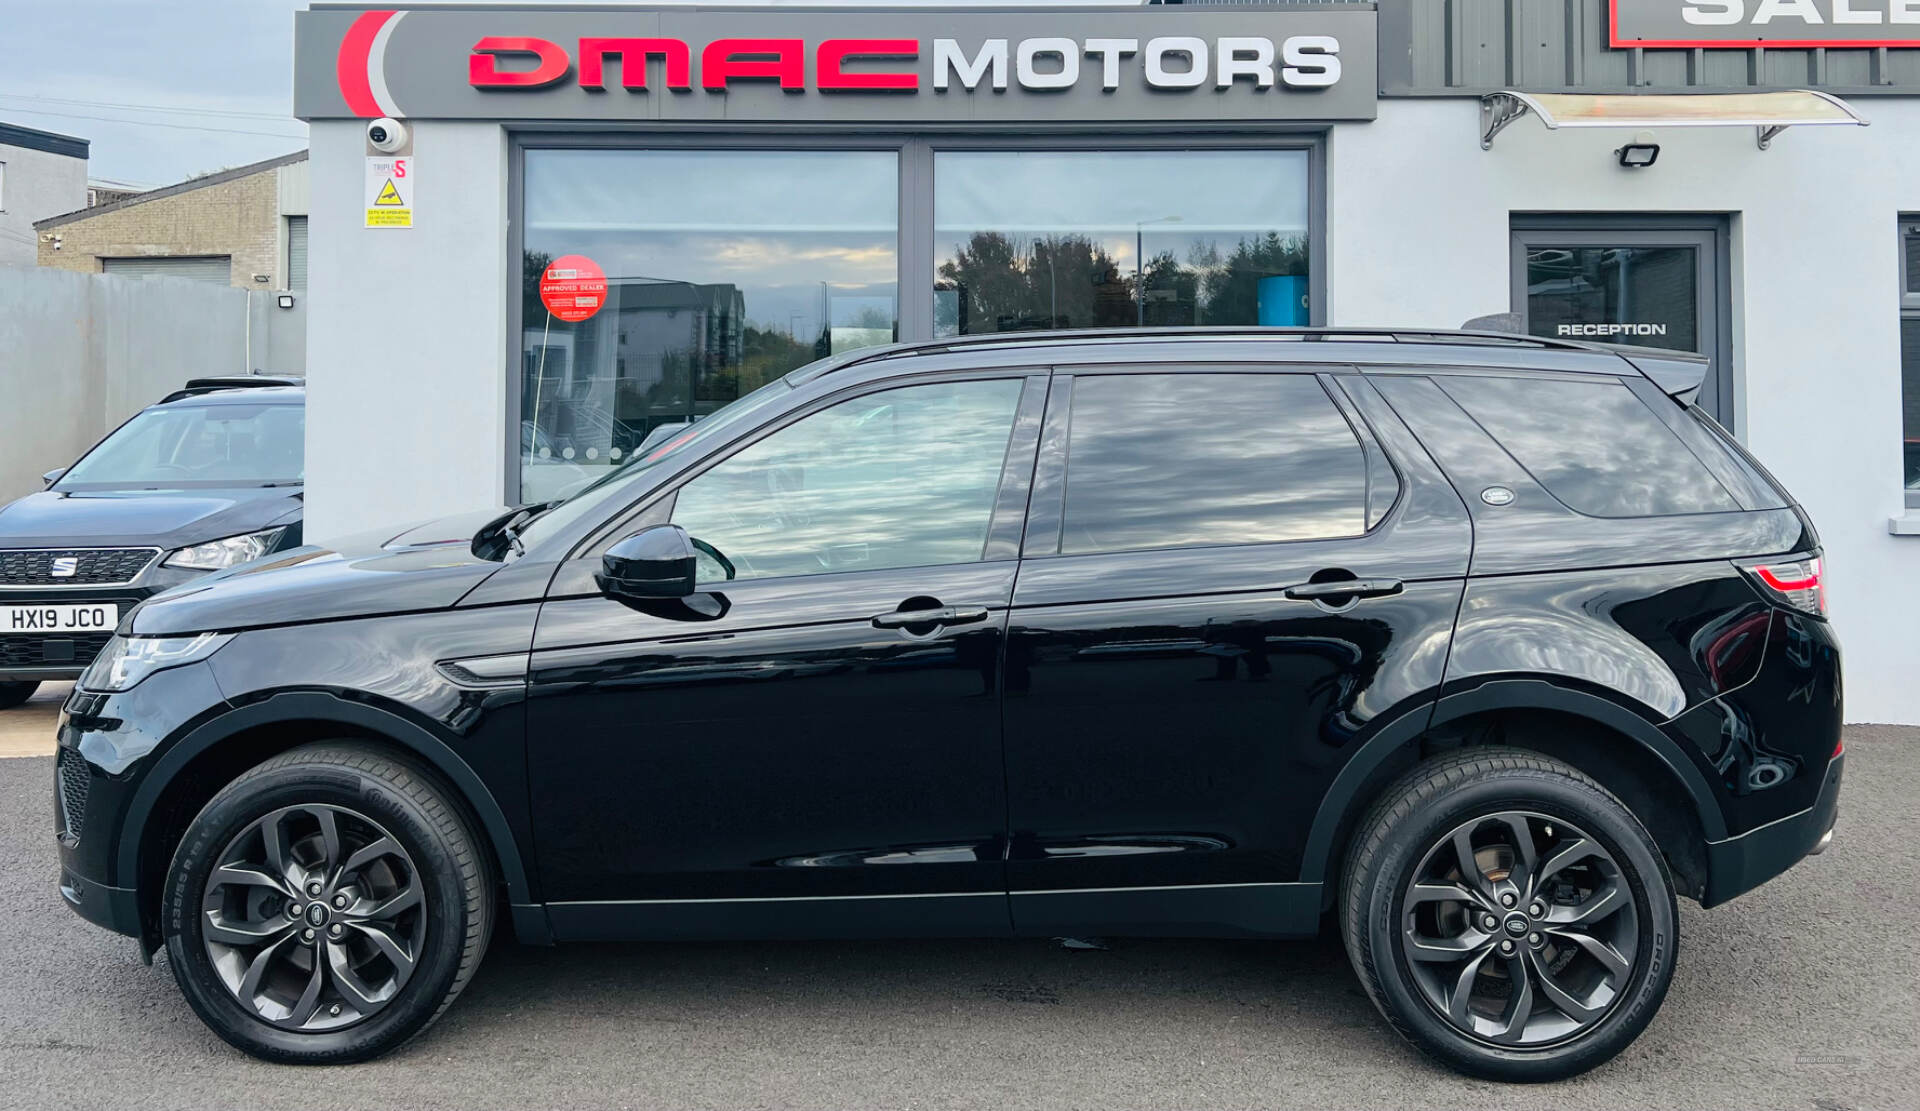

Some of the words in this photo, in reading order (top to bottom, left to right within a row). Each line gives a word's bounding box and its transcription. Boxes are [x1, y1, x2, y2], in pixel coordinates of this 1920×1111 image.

[468, 36, 920, 90] DMAC
[933, 36, 1342, 90] MOTORS
[1557, 323, 1667, 336] RECEPTION
[12, 609, 57, 629] HX19
[65, 608, 105, 628] JCO
